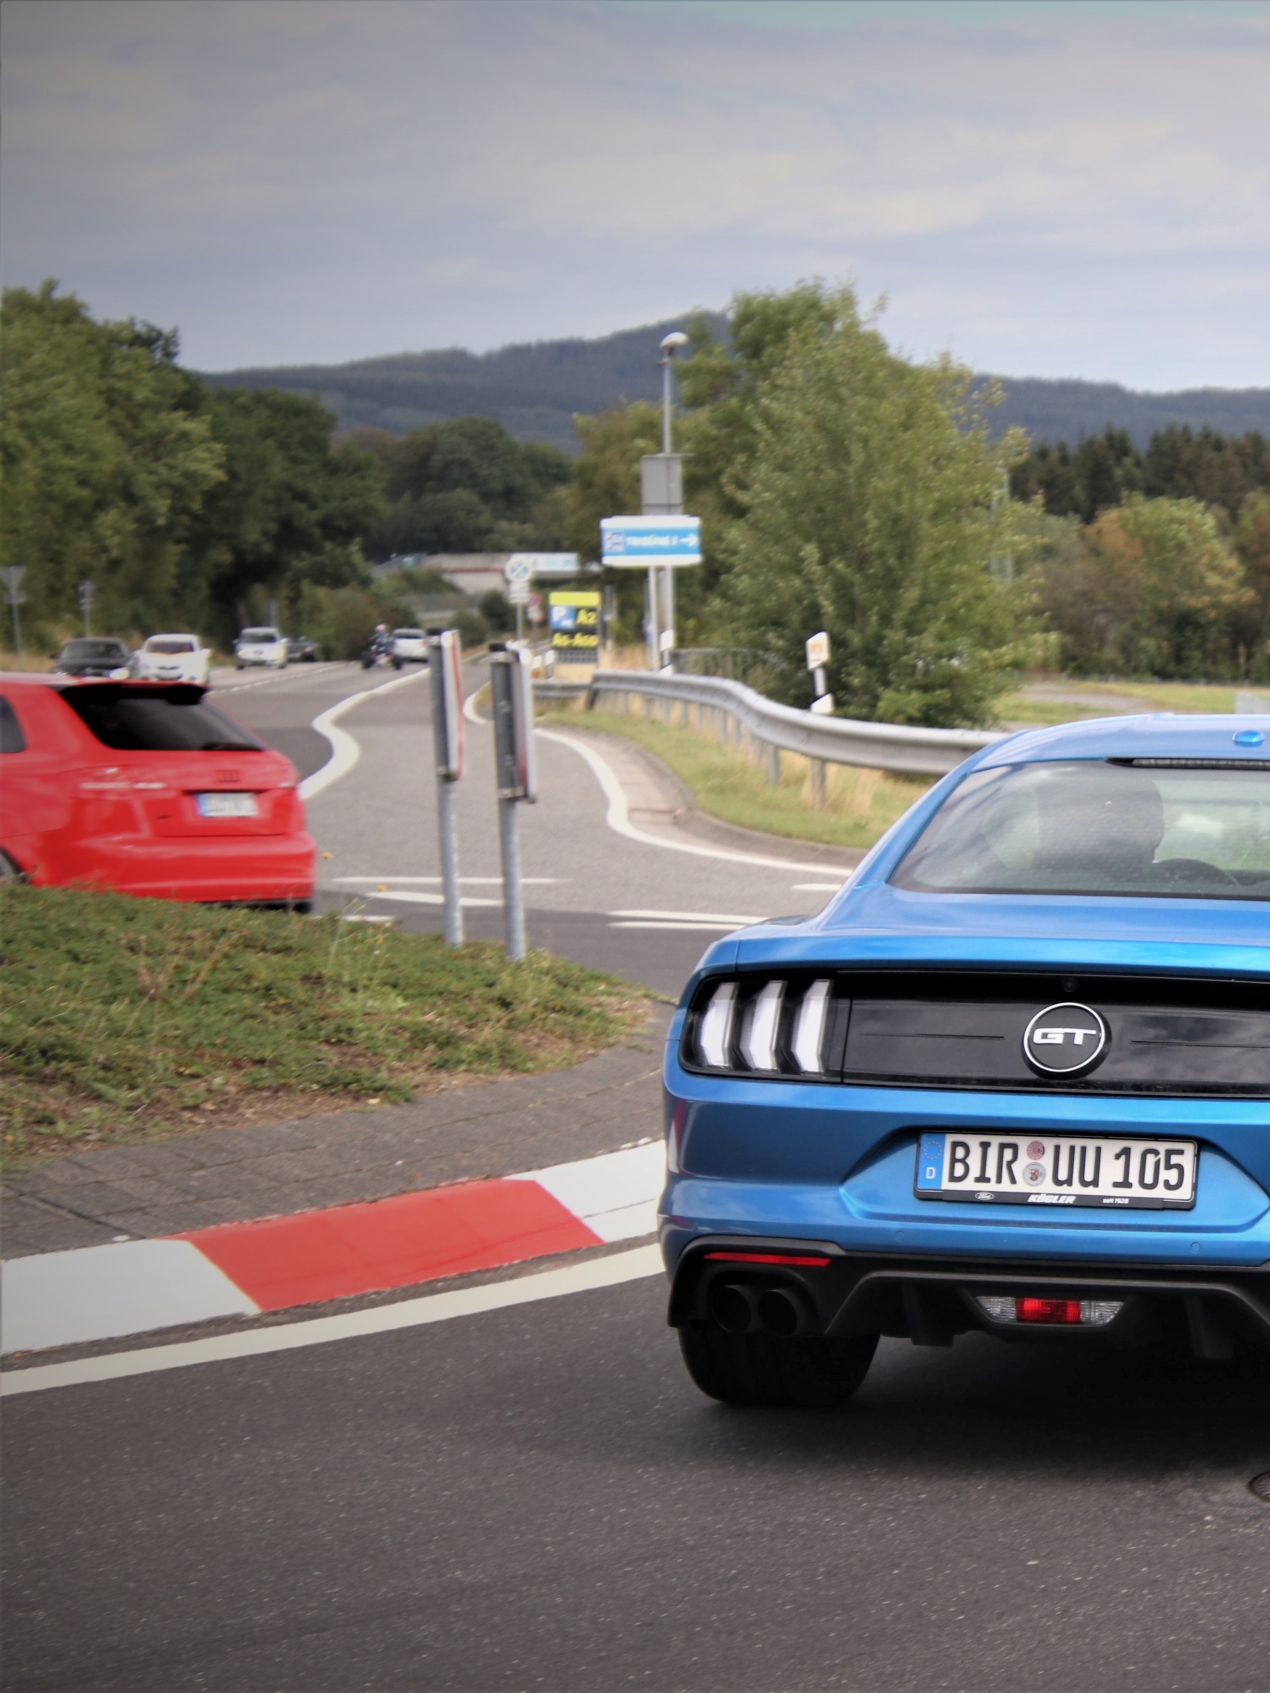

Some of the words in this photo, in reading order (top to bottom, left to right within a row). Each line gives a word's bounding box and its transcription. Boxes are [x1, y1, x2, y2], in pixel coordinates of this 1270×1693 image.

[552, 606, 567, 622] P
[576, 609, 597, 625] A2
[1033, 1027, 1097, 1045] GT
[925, 1167, 936, 1179] D
[947, 1140, 1019, 1185] BIR
[1051, 1144, 1102, 1188] UU
[1112, 1146, 1185, 1191] 105
[1027, 1193, 1076, 1204] KÖGLER
